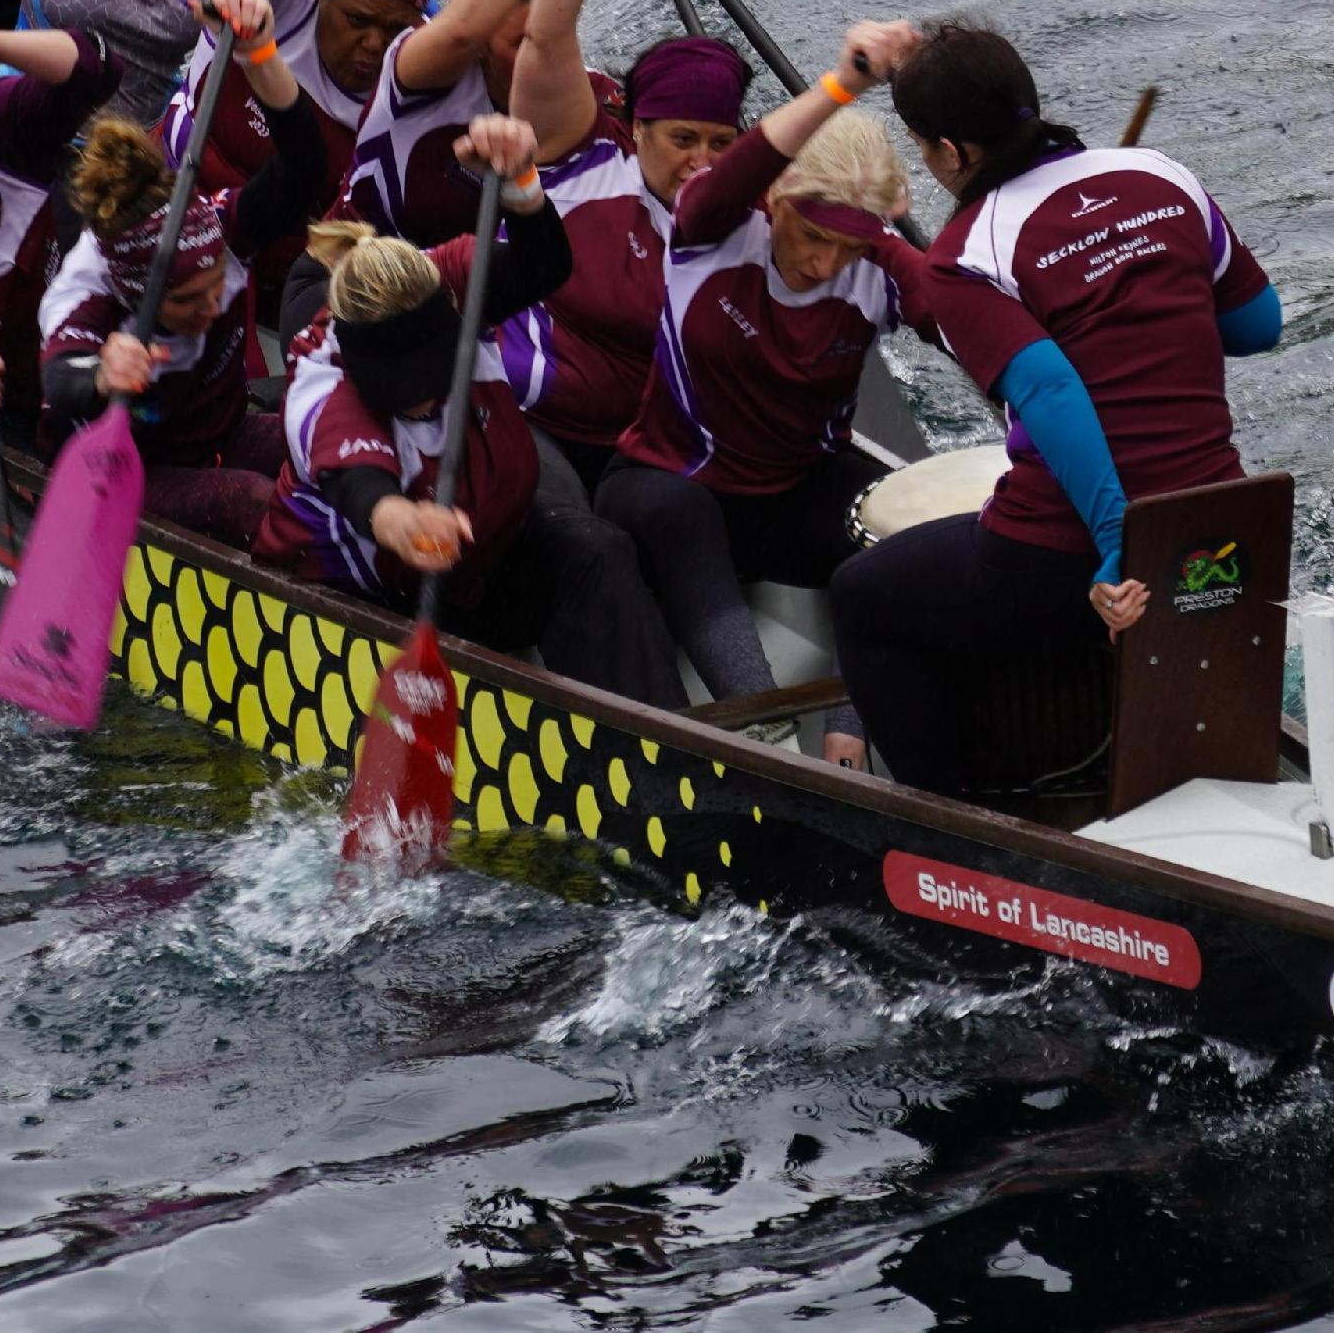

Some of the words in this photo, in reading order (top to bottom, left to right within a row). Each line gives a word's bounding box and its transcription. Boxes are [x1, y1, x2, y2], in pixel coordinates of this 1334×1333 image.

[1116, 205, 1186, 234] HUNDRED
[1174, 586, 1243, 606] PRESTON
[1180, 597, 1235, 613] DRAGONS
[918, 873, 989, 916] Spirit
[997, 898, 1022, 925] of
[1030, 902, 1170, 967] Lancashire
